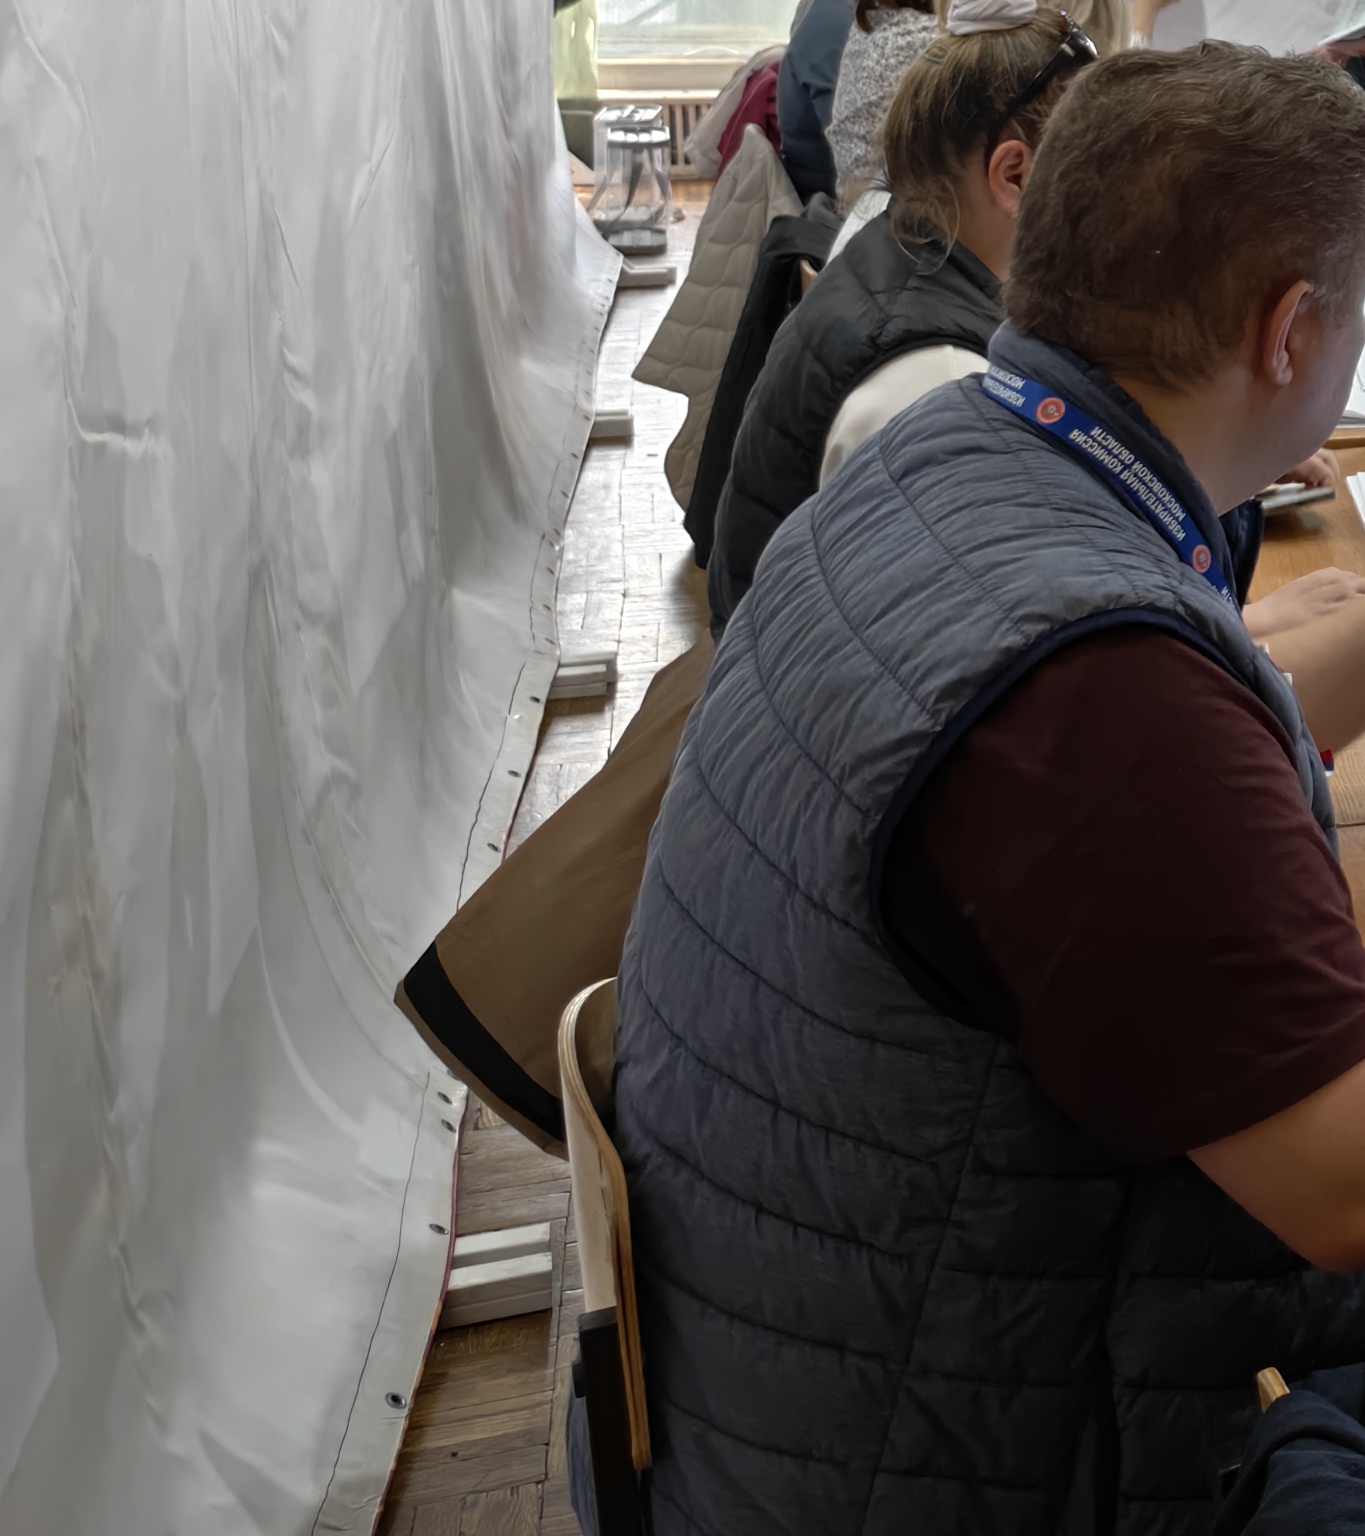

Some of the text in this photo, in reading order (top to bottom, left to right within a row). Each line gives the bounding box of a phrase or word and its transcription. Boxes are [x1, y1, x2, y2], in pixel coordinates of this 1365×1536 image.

[1069, 428, 1186, 541] ИЗБИРАТЕЛЬНАЯ КОМИССИЯ
[1091, 426, 1186, 521] МОСКОВСКОЙ ОБЛАСТИ
